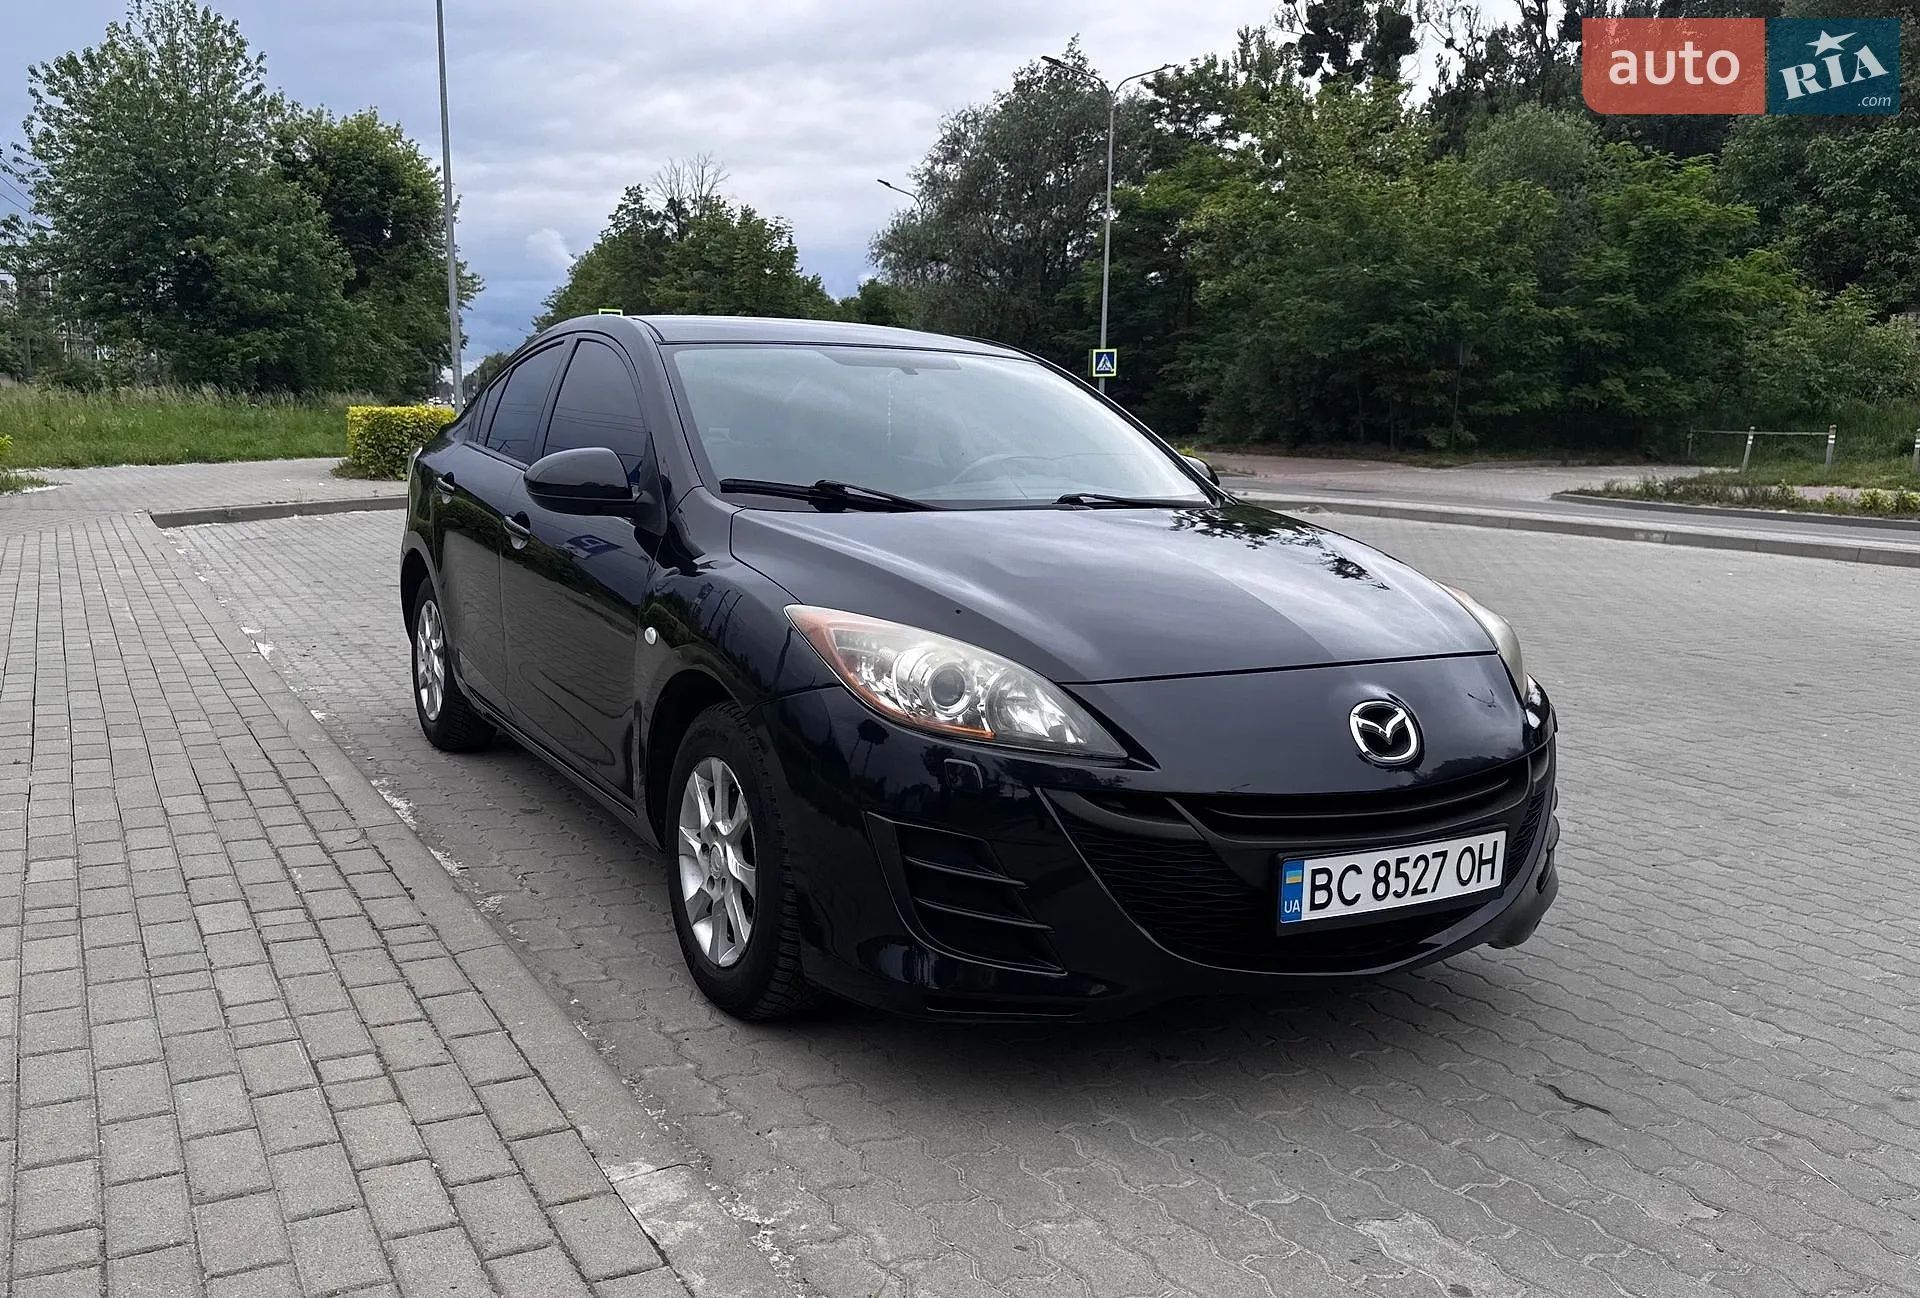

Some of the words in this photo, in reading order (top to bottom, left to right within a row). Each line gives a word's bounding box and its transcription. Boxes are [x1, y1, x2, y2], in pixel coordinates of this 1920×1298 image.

[1309, 864, 1363, 911] BC
[1372, 850, 1449, 902] 8527
[1456, 840, 1498, 887] OH
[1284, 899, 1301, 914] UA
